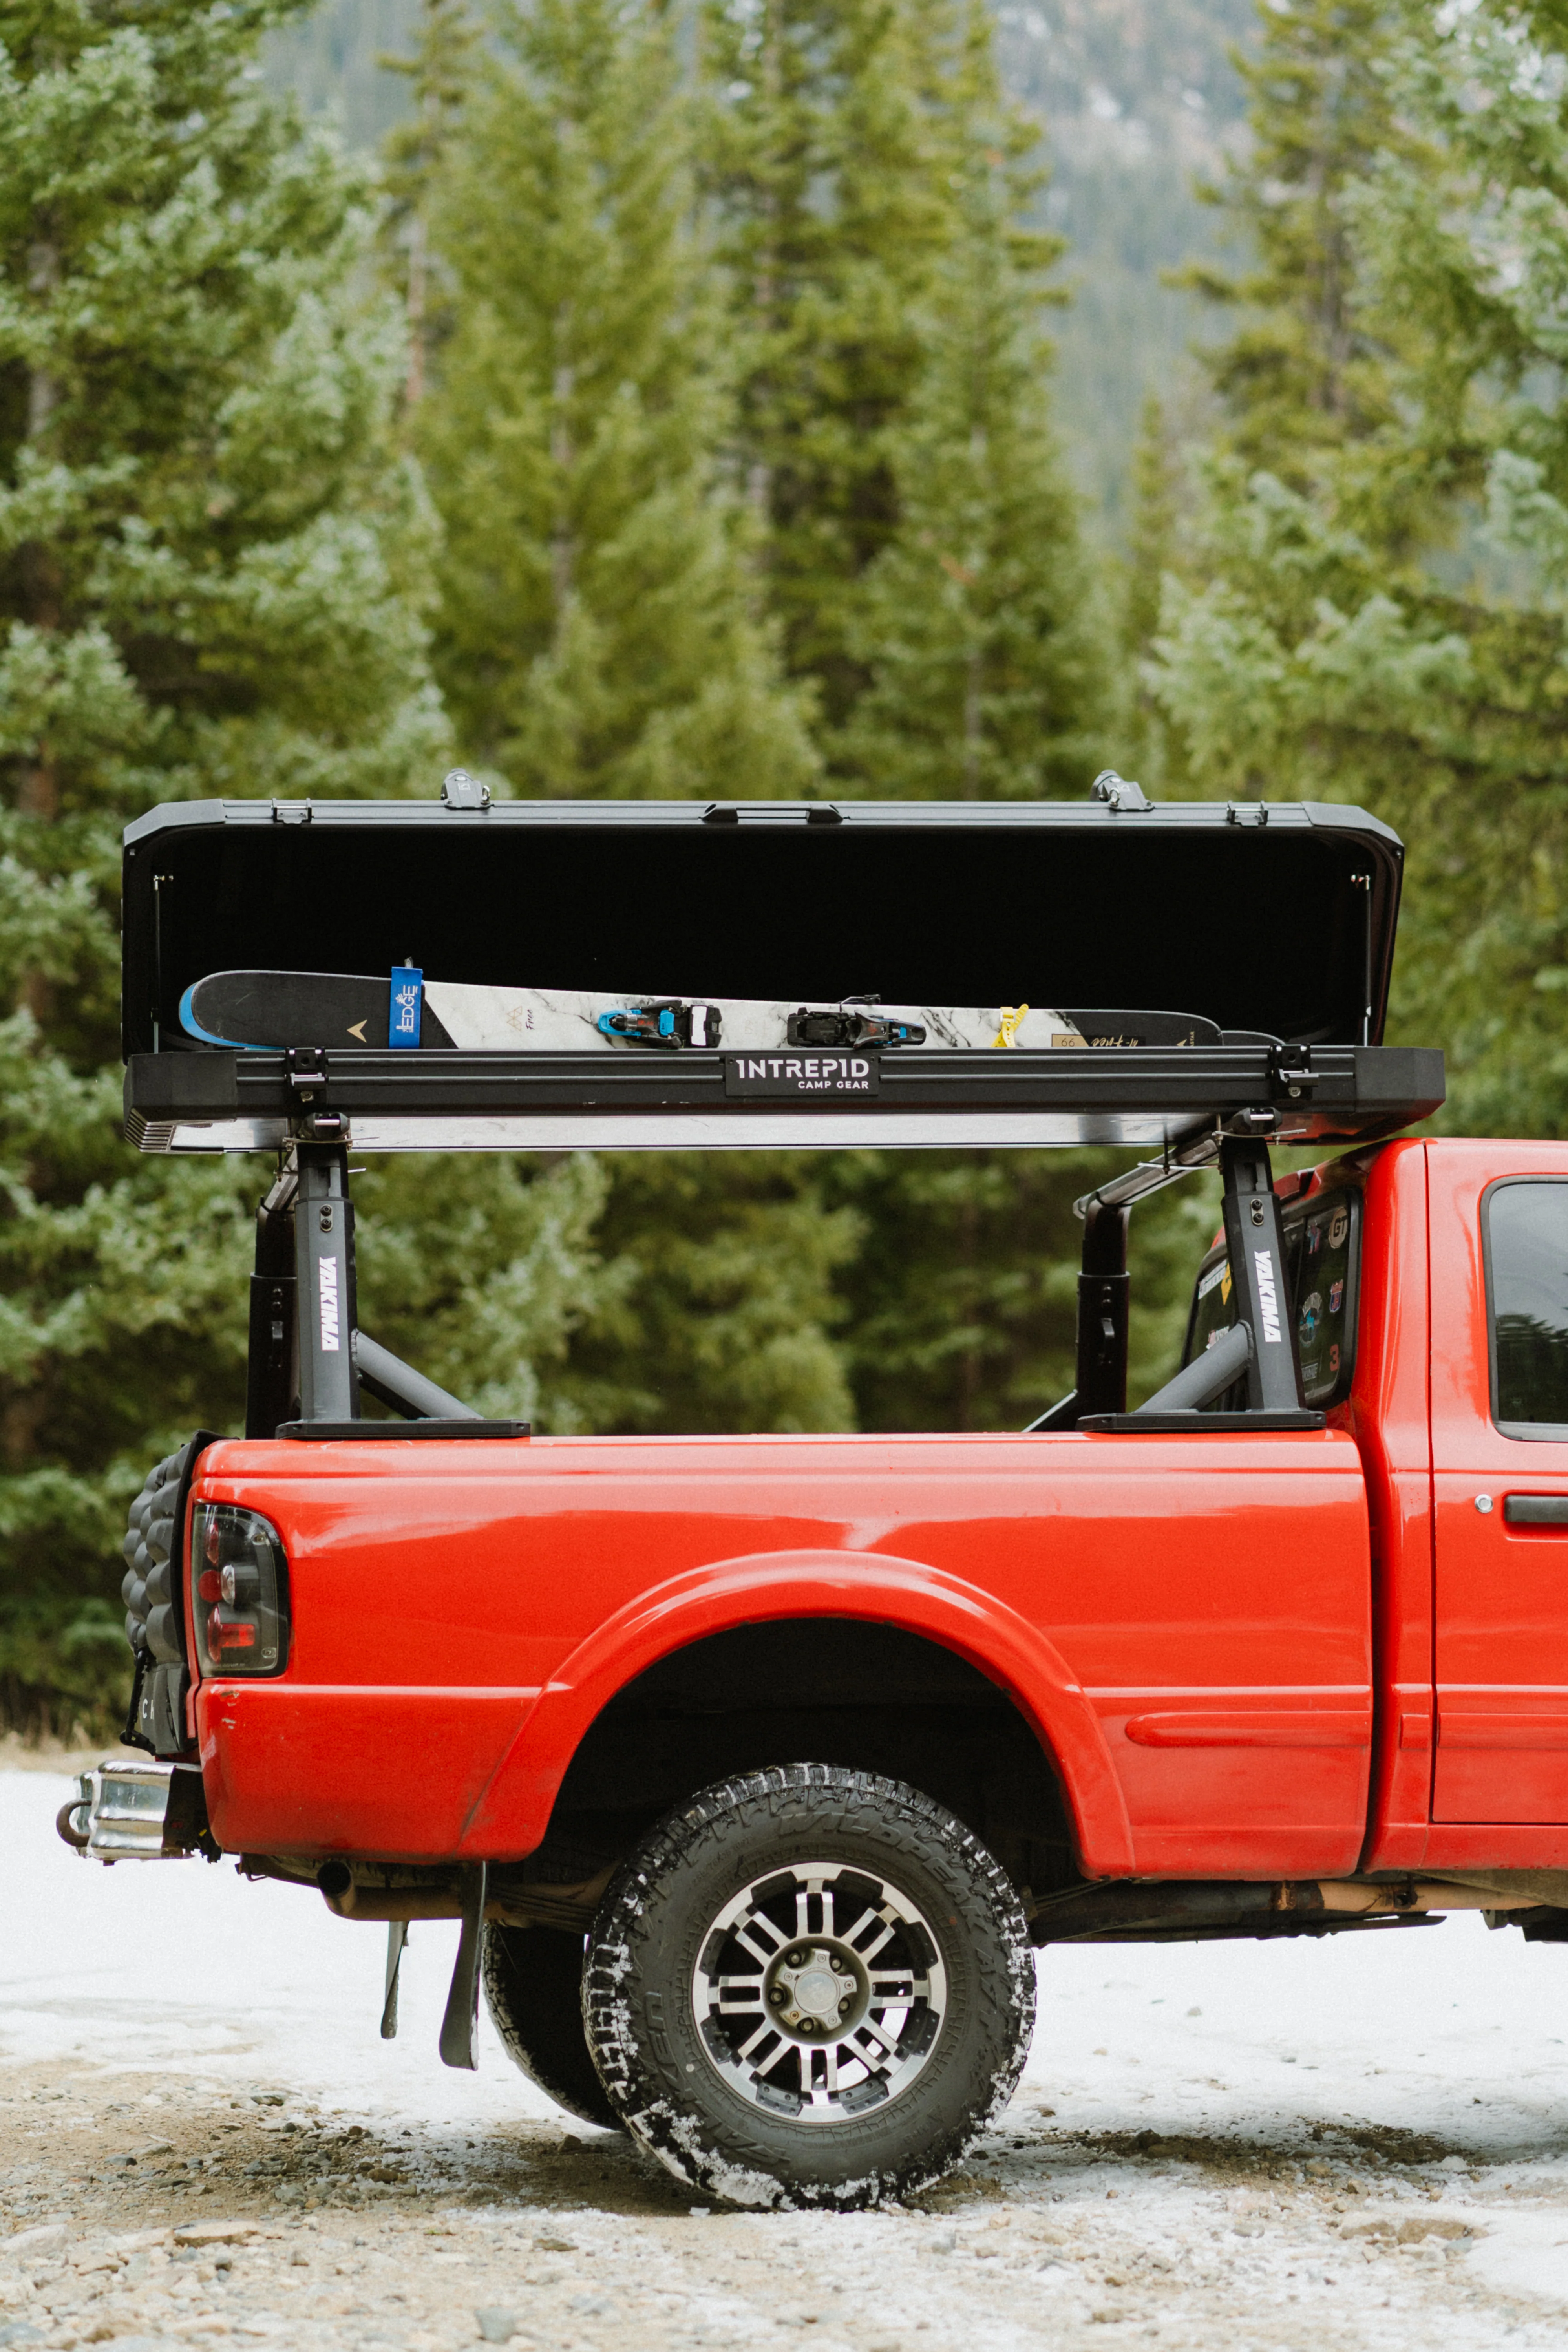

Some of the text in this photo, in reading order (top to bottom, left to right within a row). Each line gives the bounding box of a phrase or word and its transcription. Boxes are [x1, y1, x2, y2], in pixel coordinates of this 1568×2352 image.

[736, 1059, 870, 1079] INTREPID
[798, 1080, 869, 1089] CAMP GEAR
[1333, 1215, 1348, 1238] GT
[319, 1256, 339, 1351] YAKIMA
[1254, 1250, 1281, 1343] YAKIMA
[1330, 1343, 1340, 1372] 3
[780, 1811, 989, 1934] WILDPEAK
